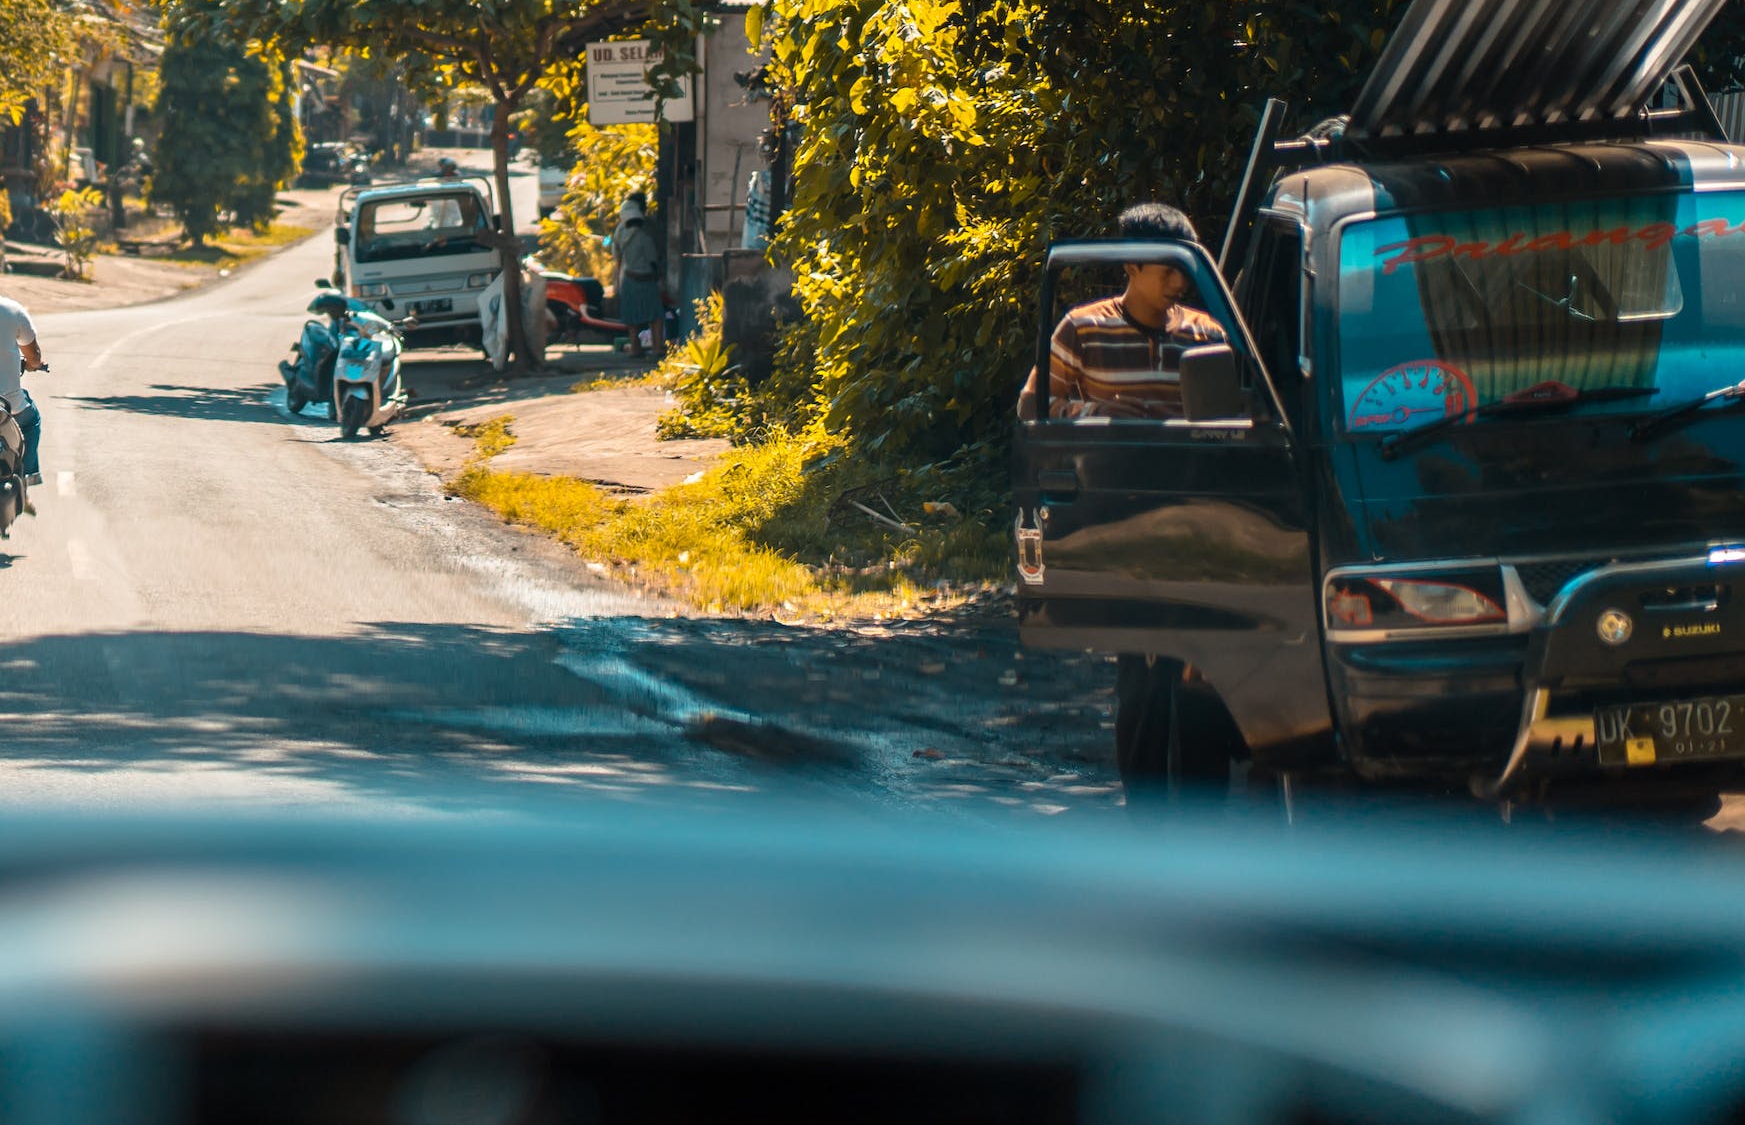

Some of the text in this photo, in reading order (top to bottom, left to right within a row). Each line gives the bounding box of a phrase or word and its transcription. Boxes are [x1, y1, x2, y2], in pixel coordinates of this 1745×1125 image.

[1374, 217, 1745, 274] Prianga
[1673, 622, 1721, 637] SUZUKI
[1599, 701, 1733, 744] DK 9702
